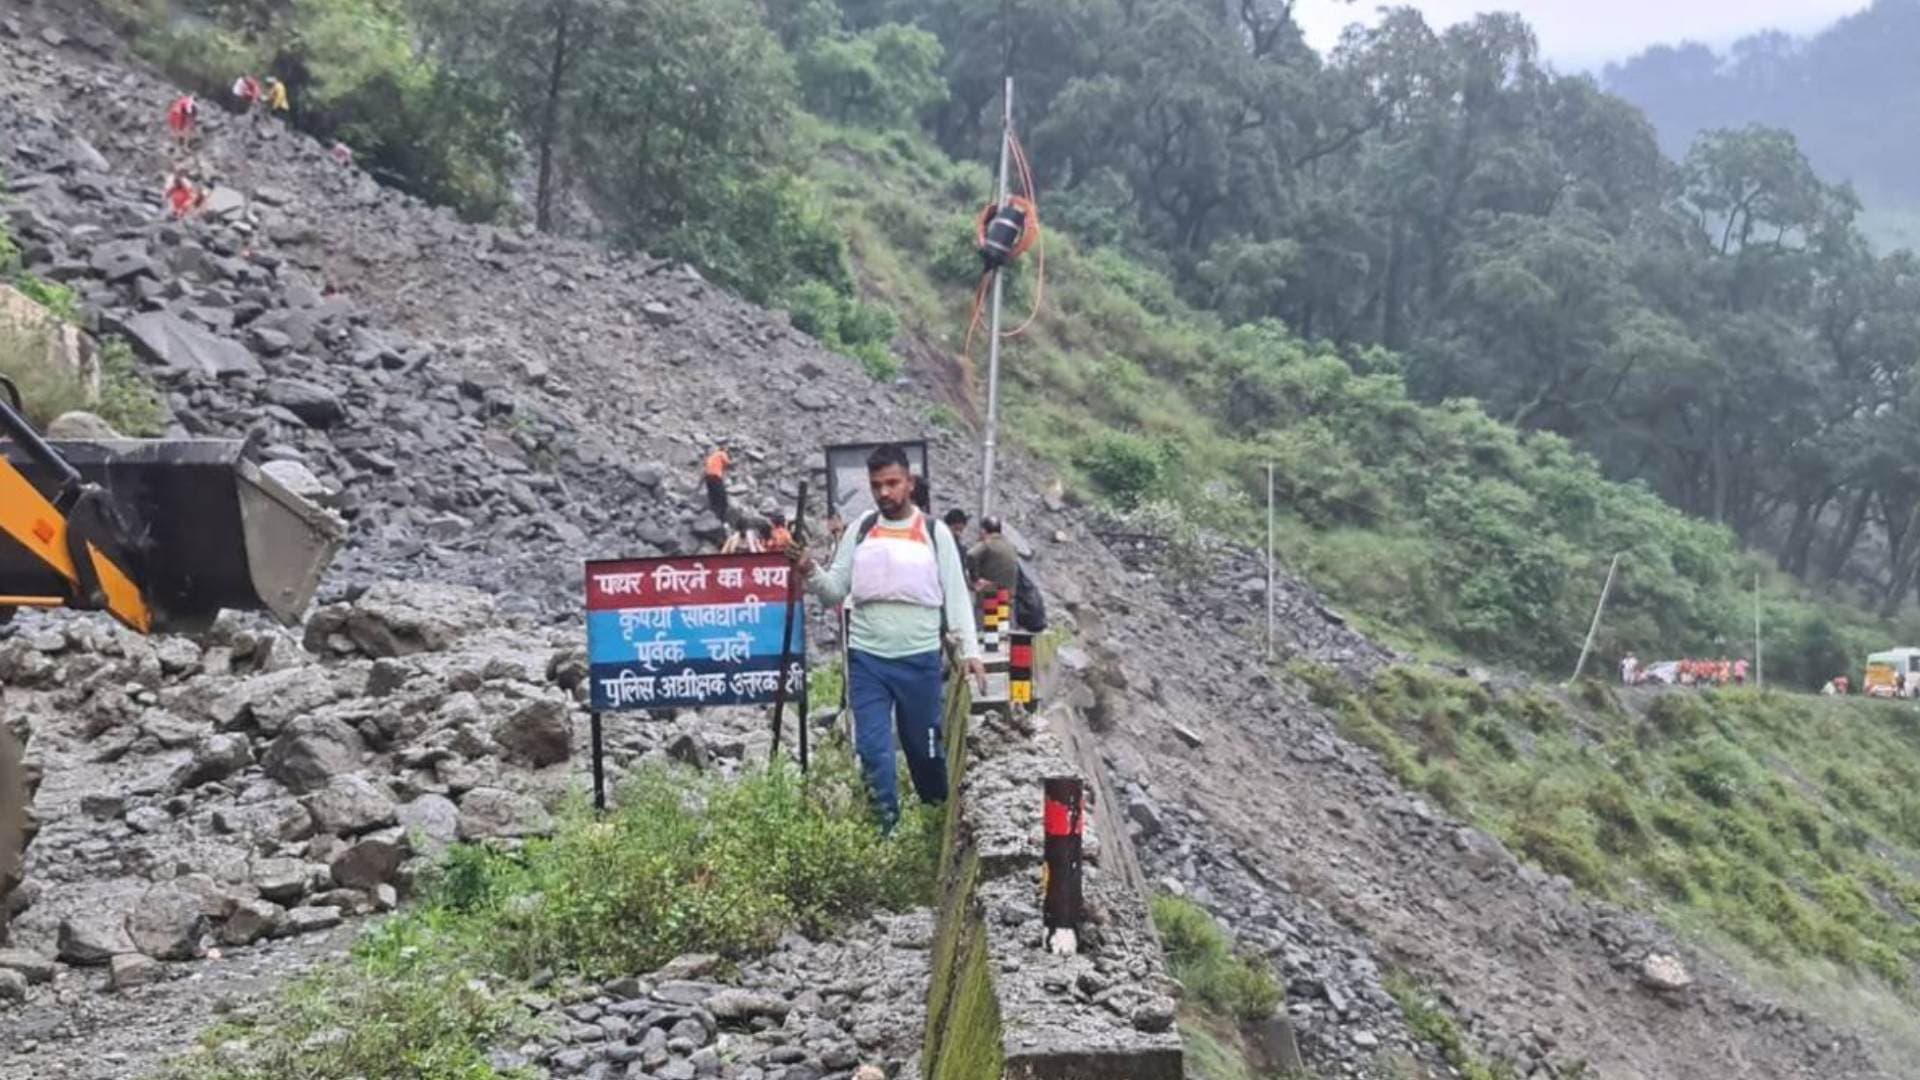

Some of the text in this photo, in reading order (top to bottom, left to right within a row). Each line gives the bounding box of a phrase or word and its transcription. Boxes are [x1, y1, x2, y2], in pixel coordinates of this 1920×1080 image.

[651, 563, 711, 594] गिरने
[717, 568, 743, 589] का
[752, 566, 790, 588] भय
[618, 594, 766, 640] कृपया सावधानी
[634, 631, 755, 671] पूर्वक चलें
[600, 669, 655, 708] पुलिस
[729, 662, 804, 698] उत्तरकशी
